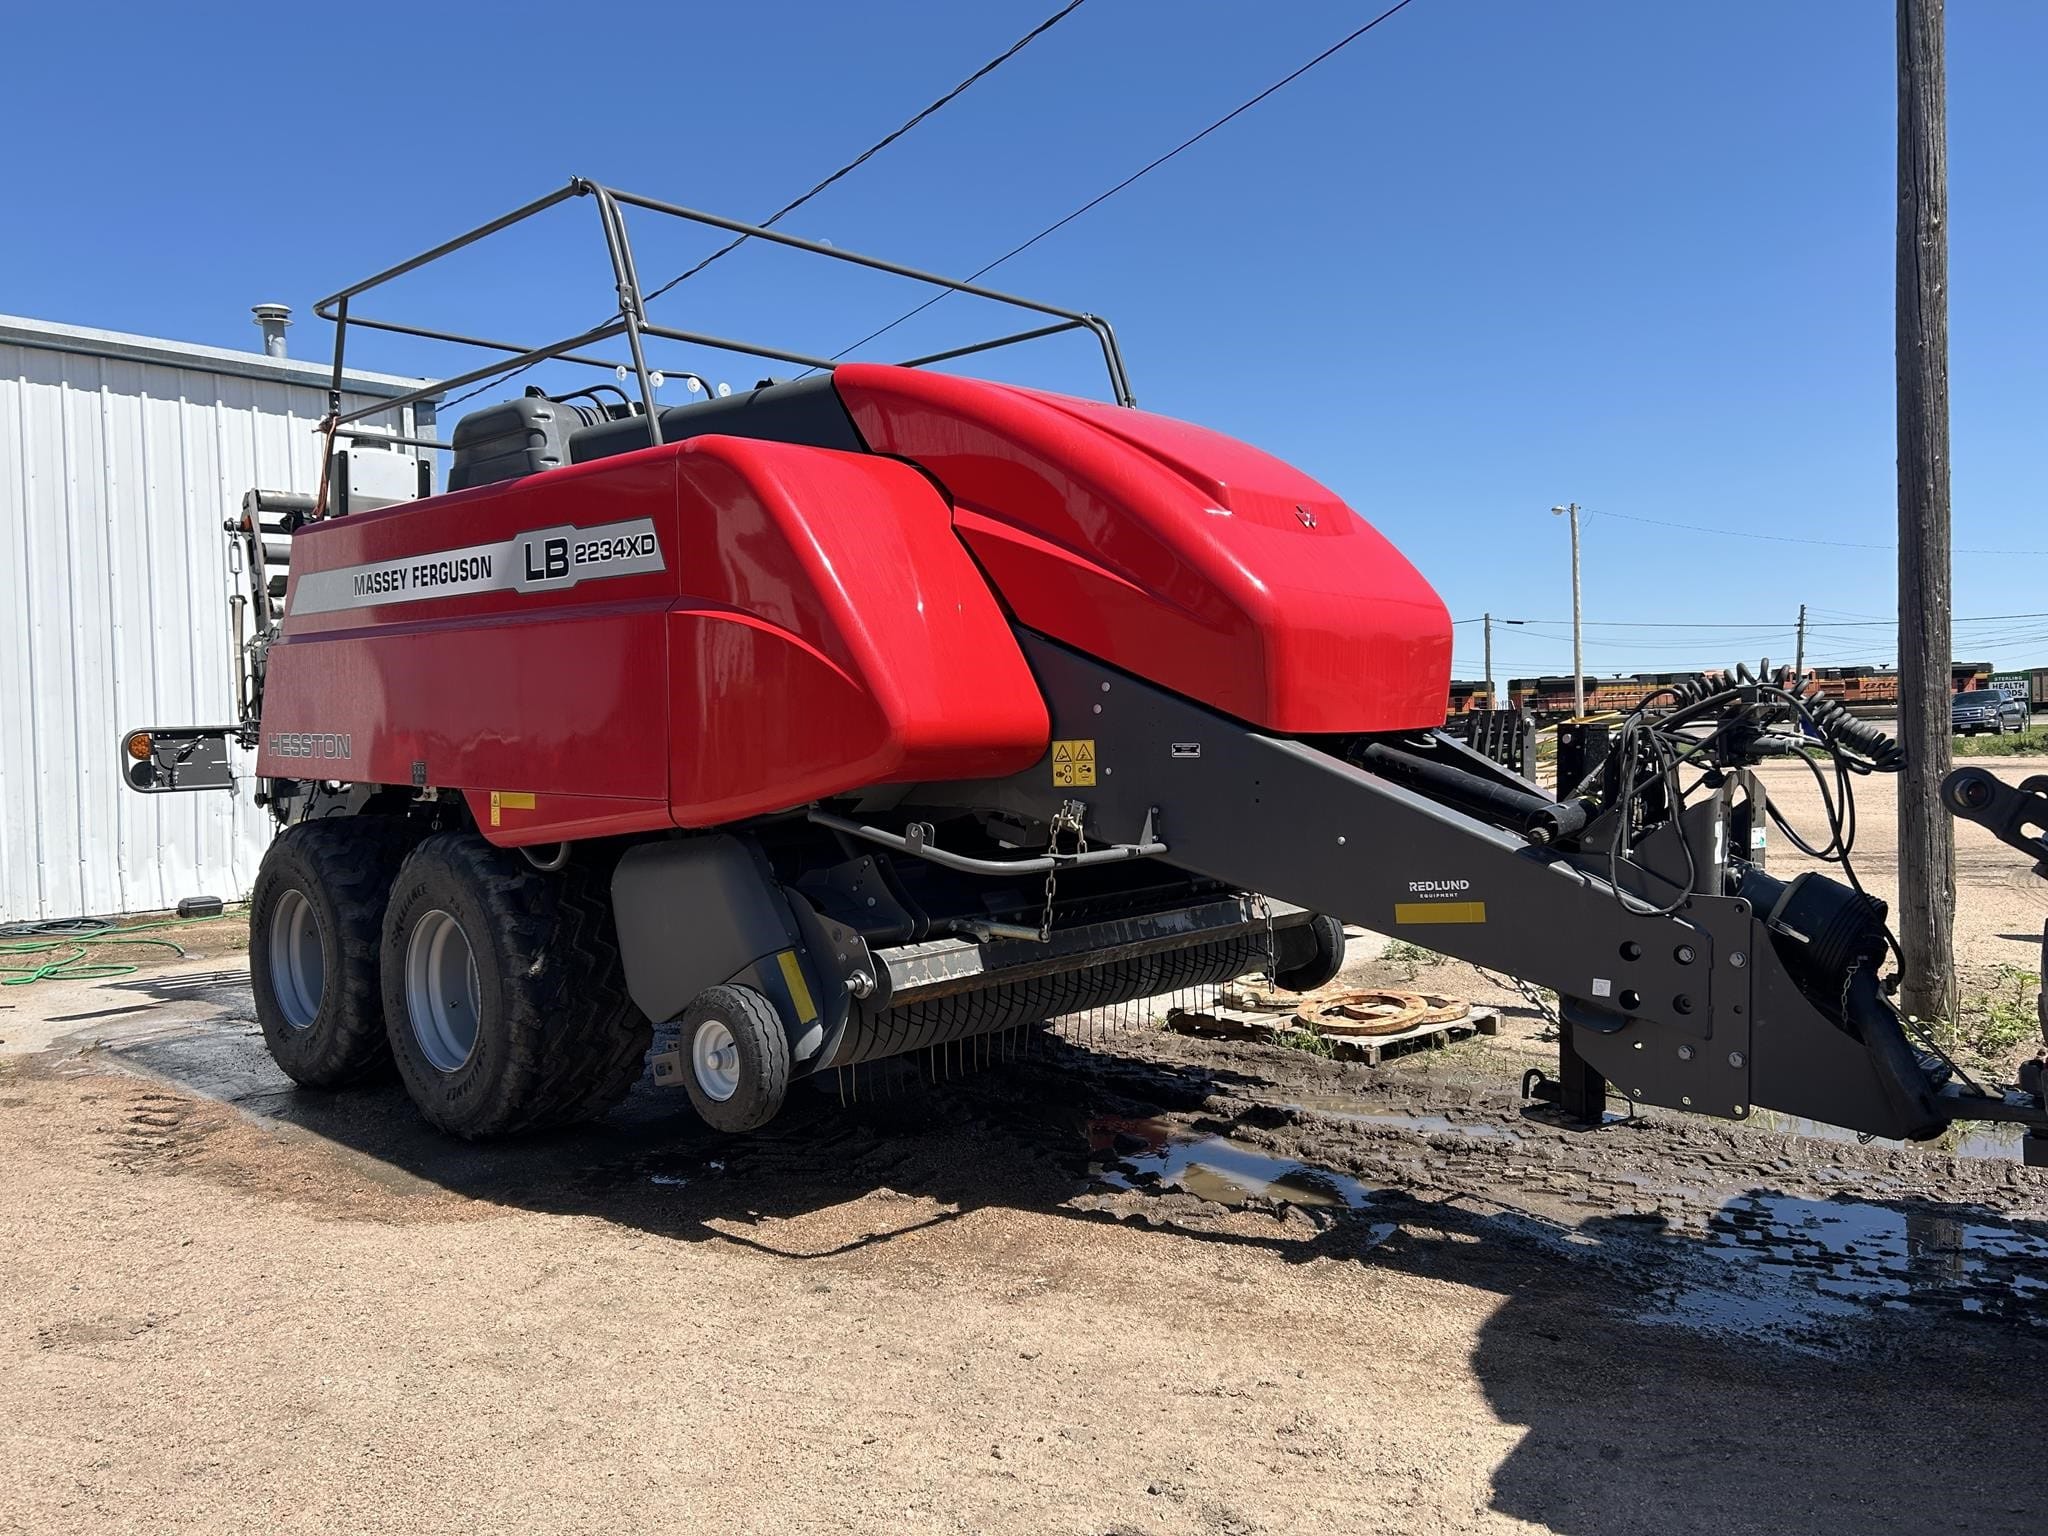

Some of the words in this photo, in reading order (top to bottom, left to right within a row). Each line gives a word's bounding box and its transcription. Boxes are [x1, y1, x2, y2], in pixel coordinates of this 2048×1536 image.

[353, 567, 408, 597] MASSEY
[411, 554, 493, 588] FERGUSON
[524, 536, 570, 583] LB
[574, 532, 656, 566] 2234XD
[1992, 682, 2025, 690] HEALTH
[267, 732, 352, 760] HESSTON
[1408, 880, 1470, 892] REDLUND
